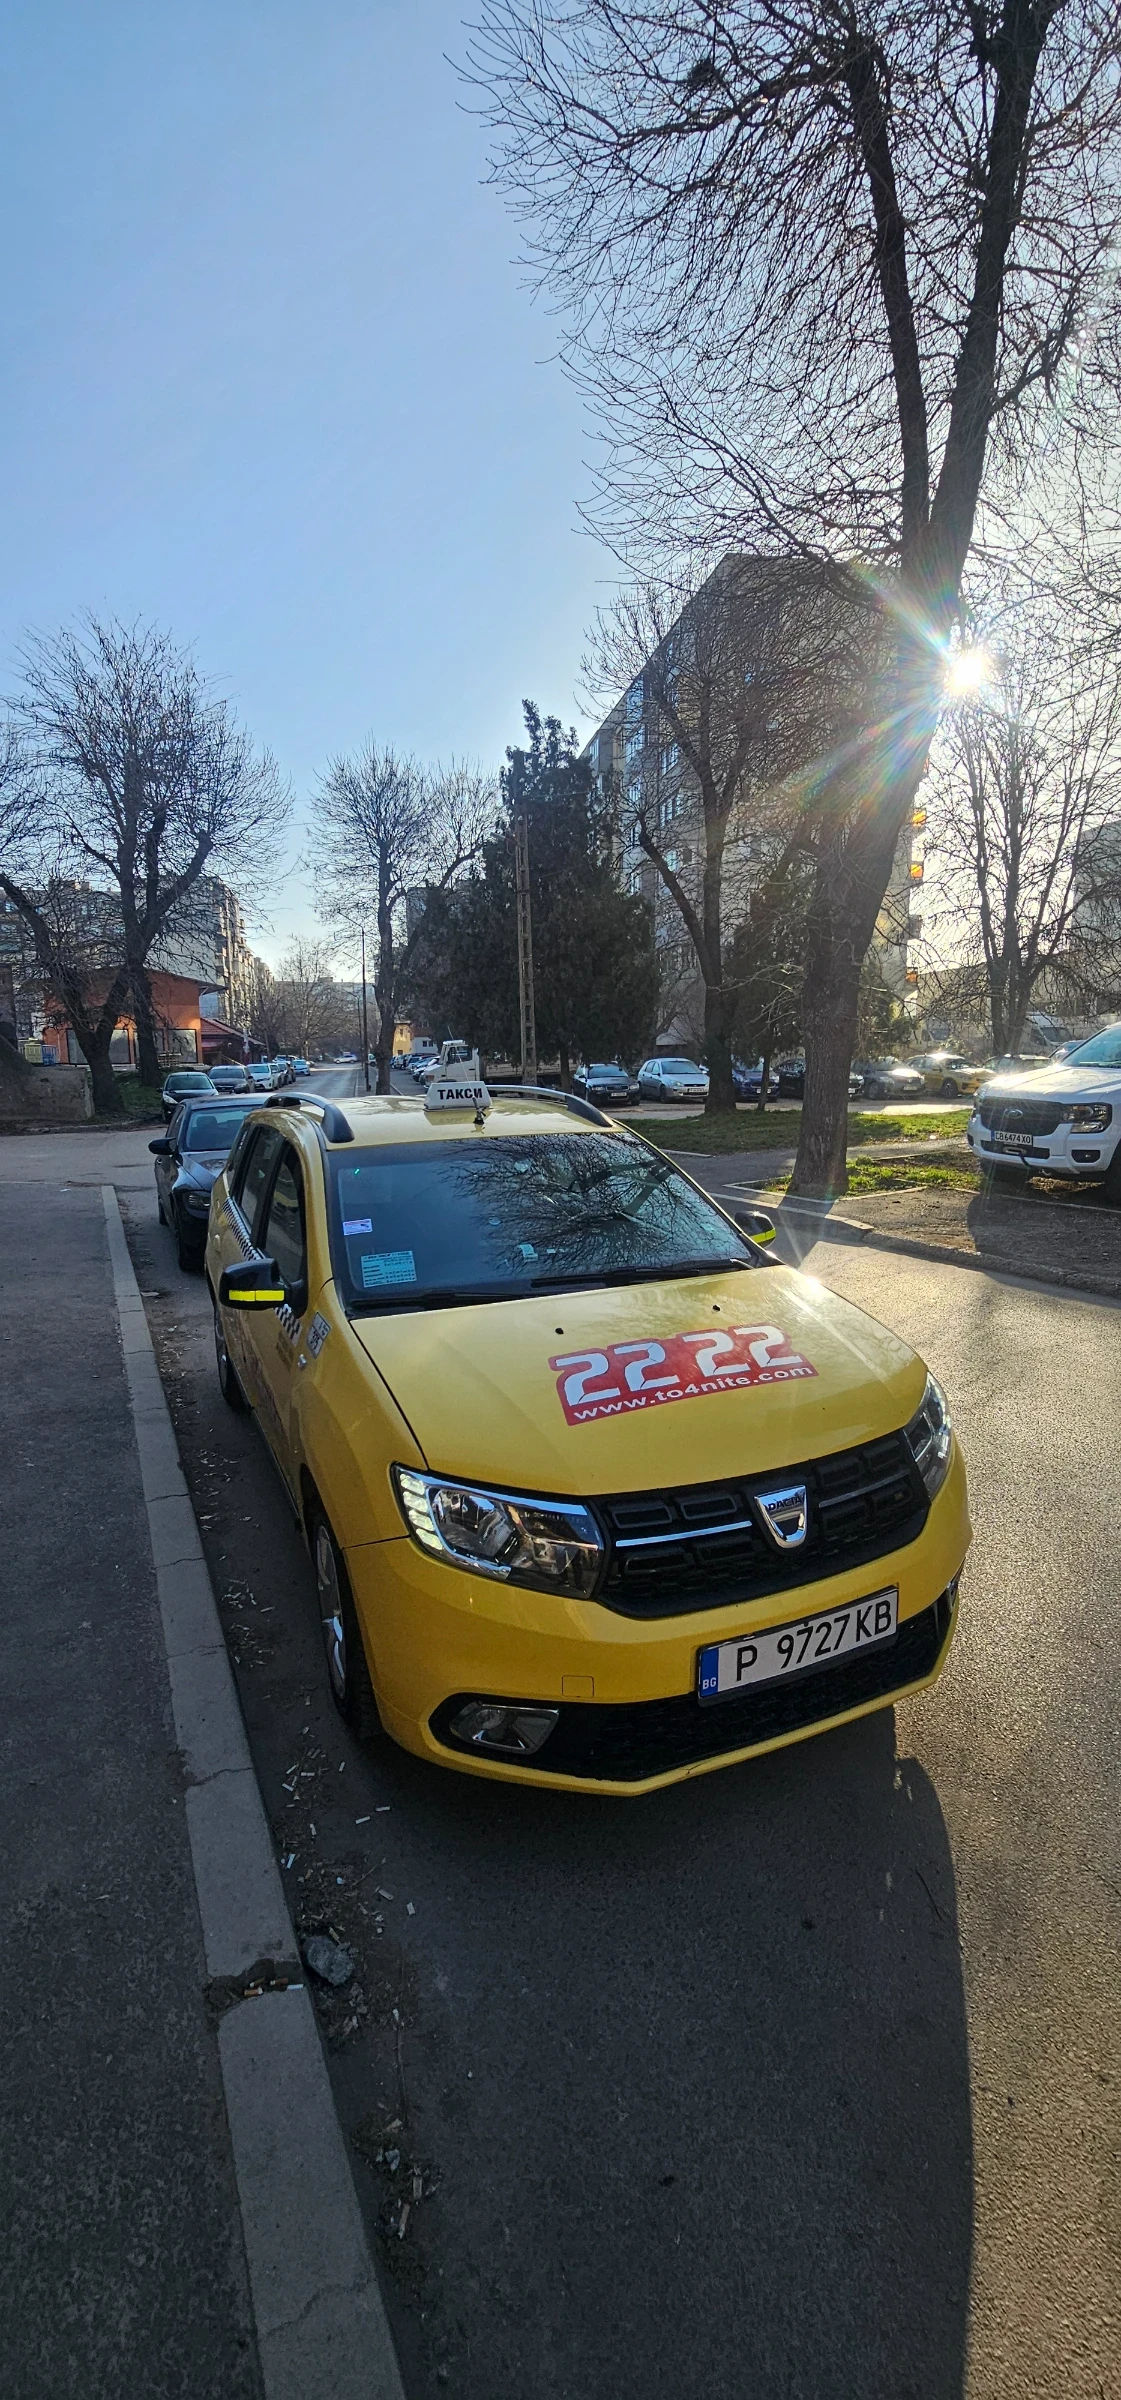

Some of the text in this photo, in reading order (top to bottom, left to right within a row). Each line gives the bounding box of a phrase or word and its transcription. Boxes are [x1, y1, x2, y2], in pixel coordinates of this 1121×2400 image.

[437, 1088, 483, 1100] ТАКСИ
[574, 1366, 812, 1419] www.to4nite.com
[768, 1495, 801, 1511] DACIA
[736, 1644, 758, 1682] P
[702, 1677, 717, 1690] BG
